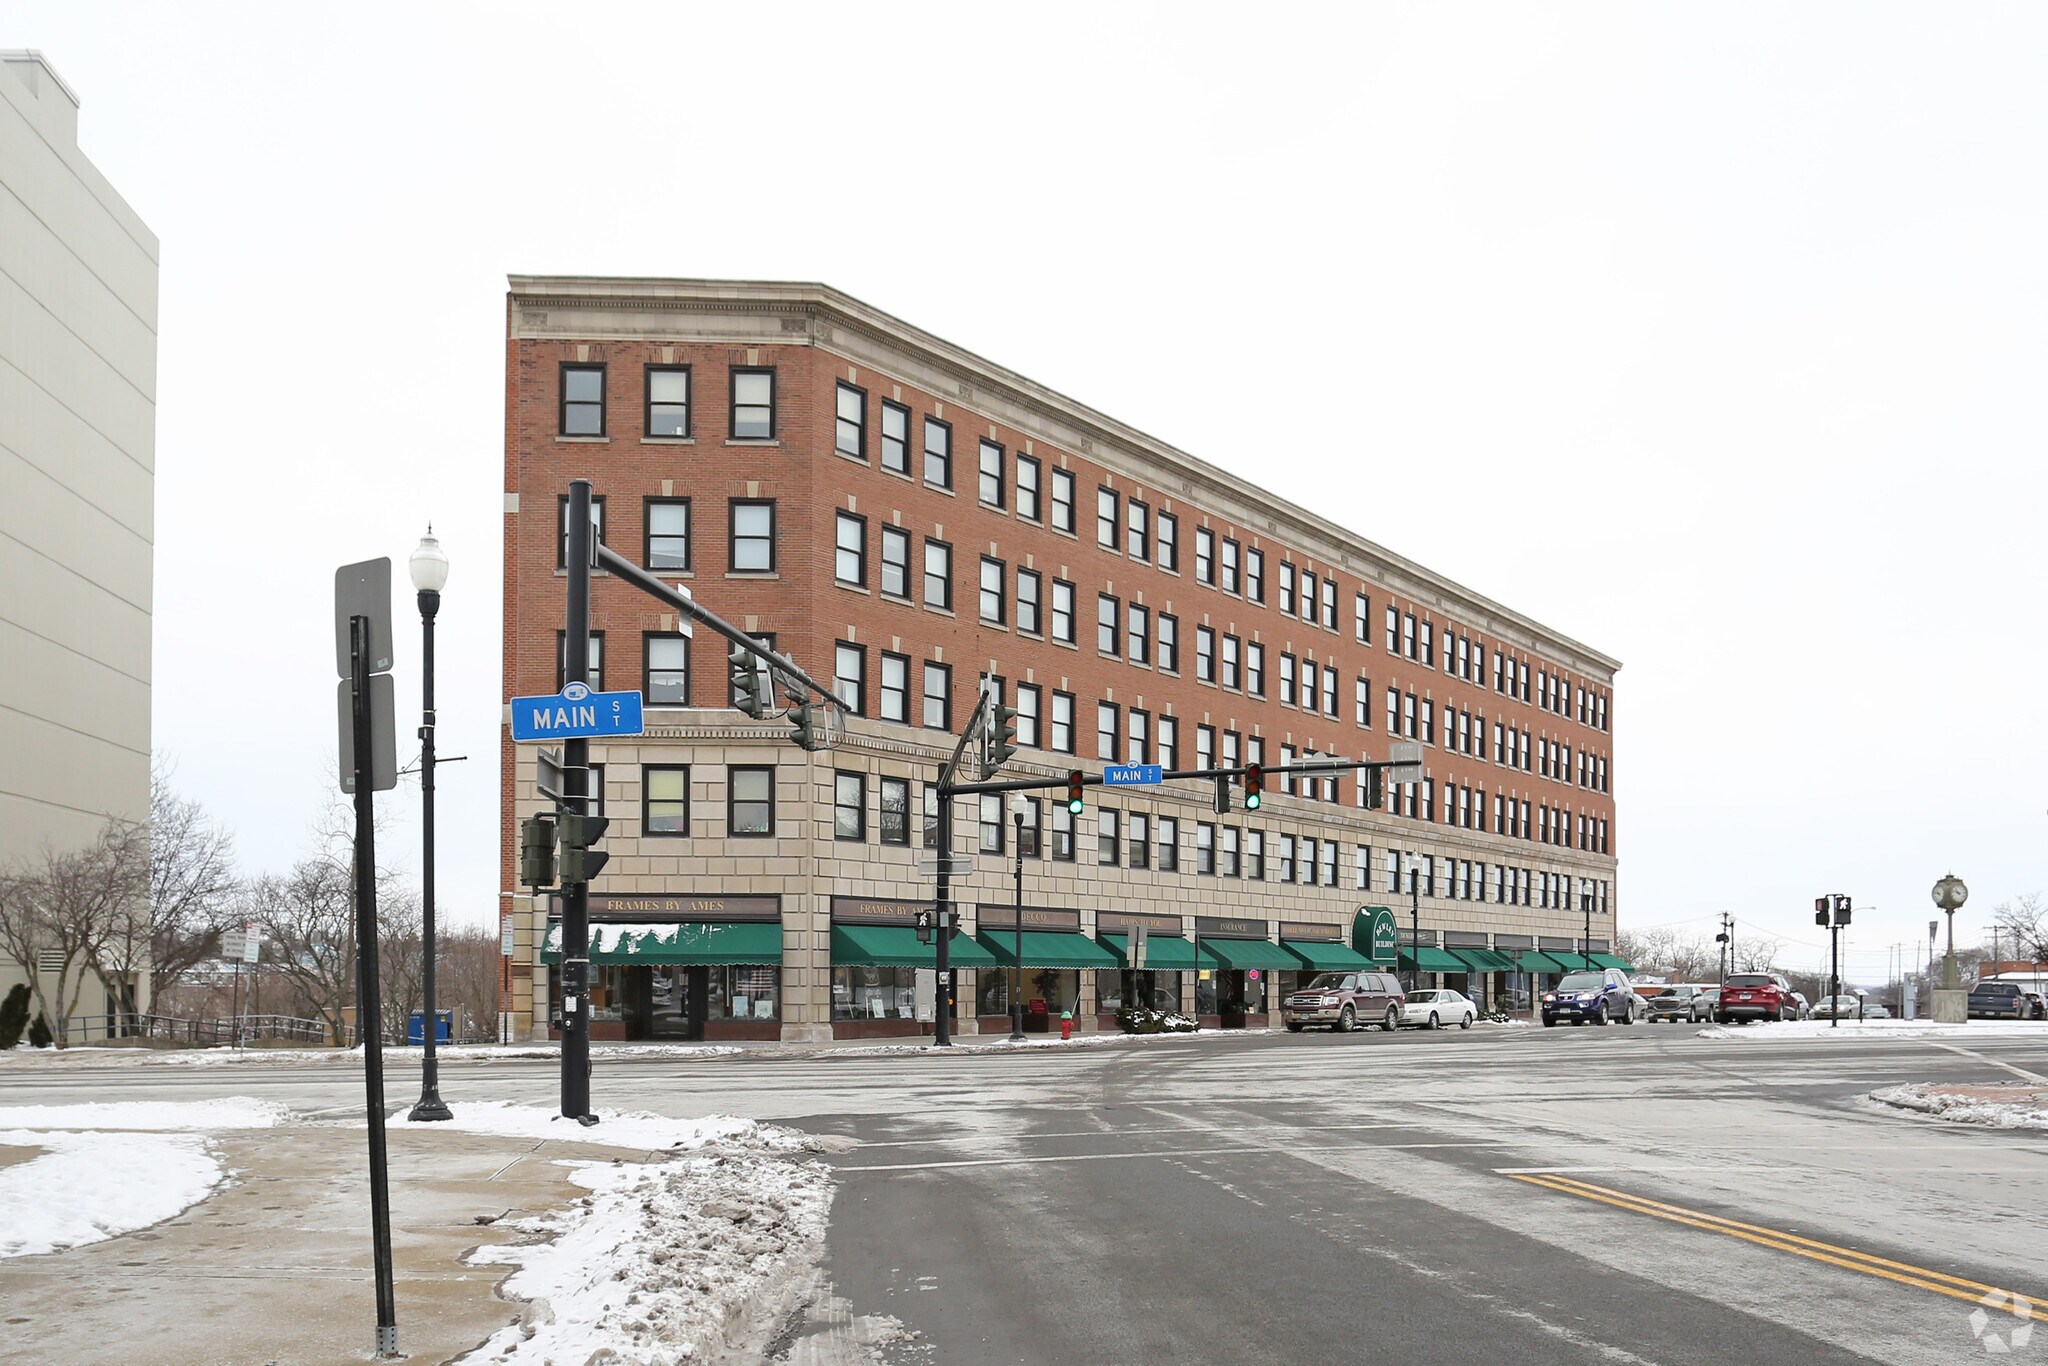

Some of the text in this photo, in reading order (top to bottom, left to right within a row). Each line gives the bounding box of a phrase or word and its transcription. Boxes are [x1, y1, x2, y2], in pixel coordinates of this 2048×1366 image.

[533, 706, 595, 730] MAIN
[1113, 771, 1141, 781] MAIN
[607, 900, 724, 911] FRAMES BY AMES
[860, 904, 894, 915] FRAMES
[897, 906, 908, 916] BY
[1019, 912, 1047, 922] DECCO
[1140, 918, 1148, 926] TO
[1149, 919, 1160, 927] YOU
